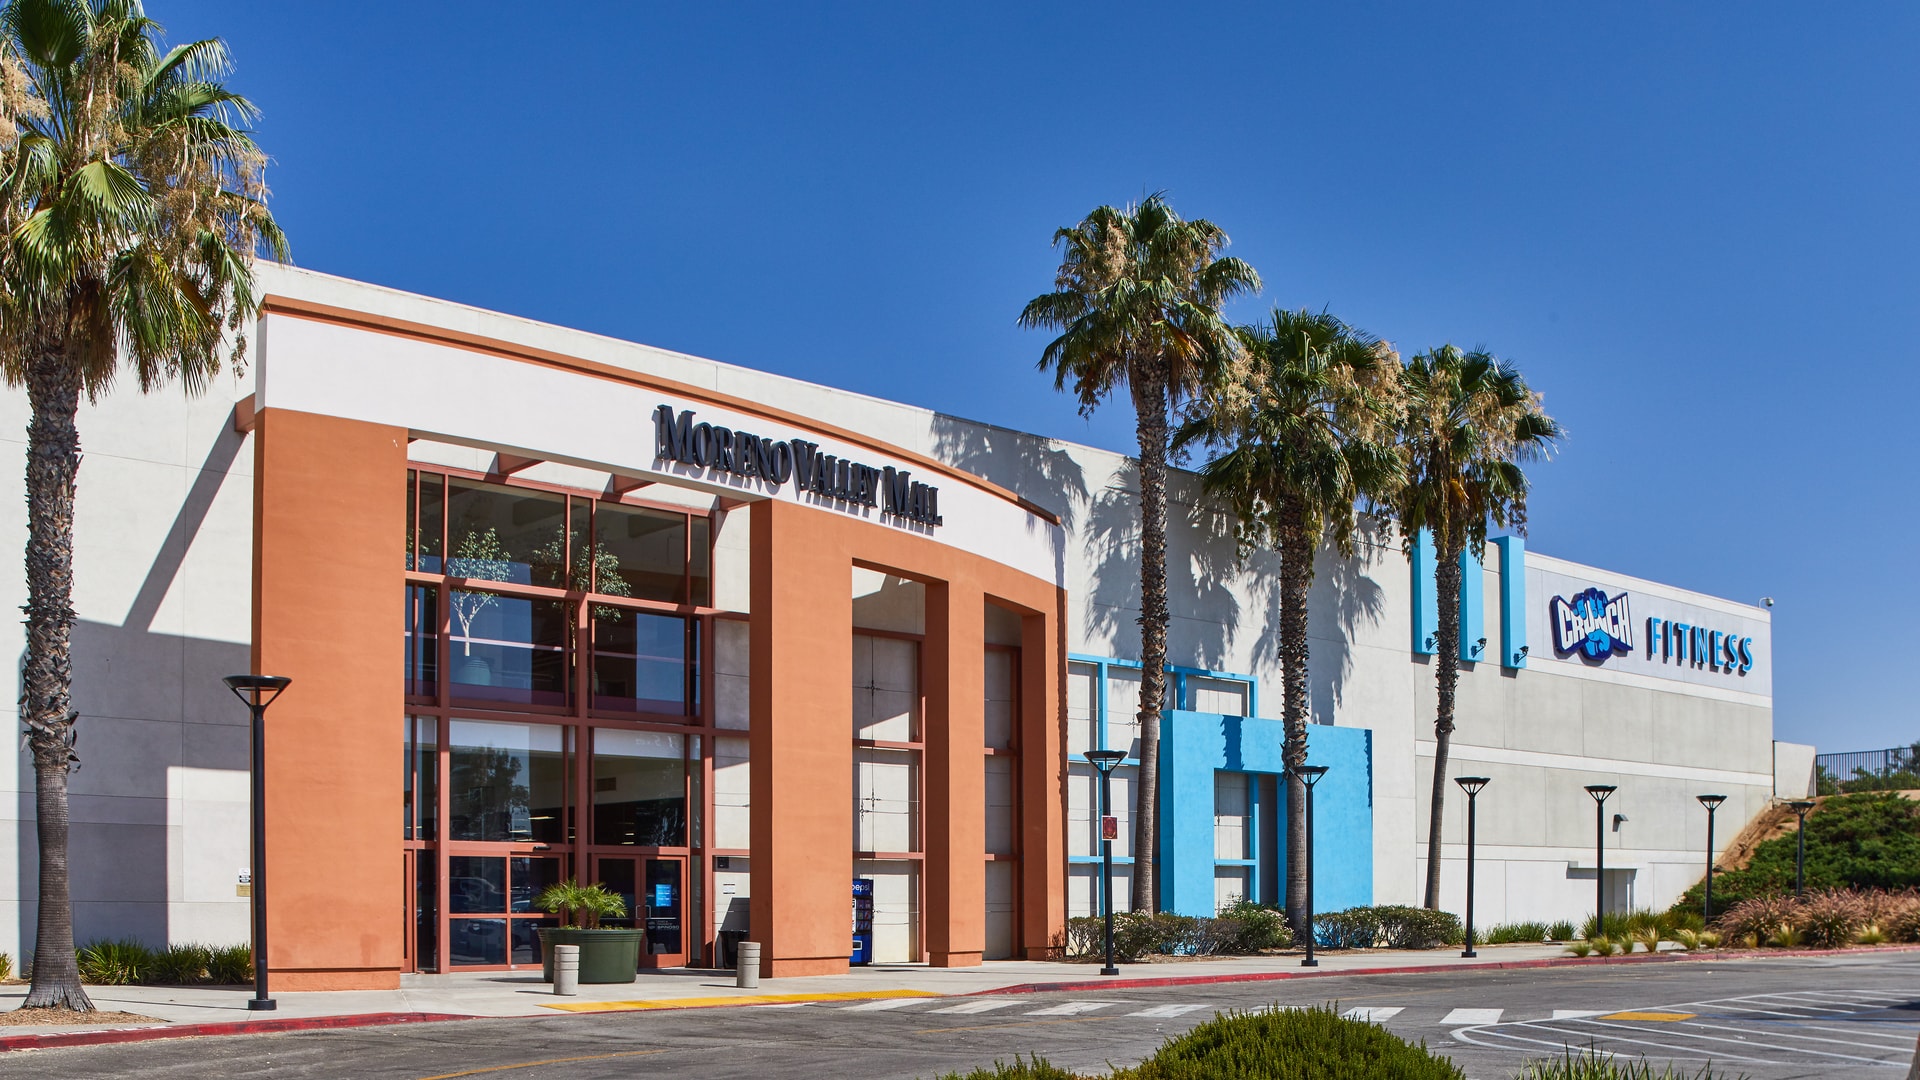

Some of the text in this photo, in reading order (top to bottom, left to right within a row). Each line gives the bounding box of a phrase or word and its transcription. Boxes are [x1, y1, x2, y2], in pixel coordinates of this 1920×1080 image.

[655, 404, 943, 527] MORENO VALLEY MALL
[1557, 594, 1753, 672] CRUNCH FITNESS
